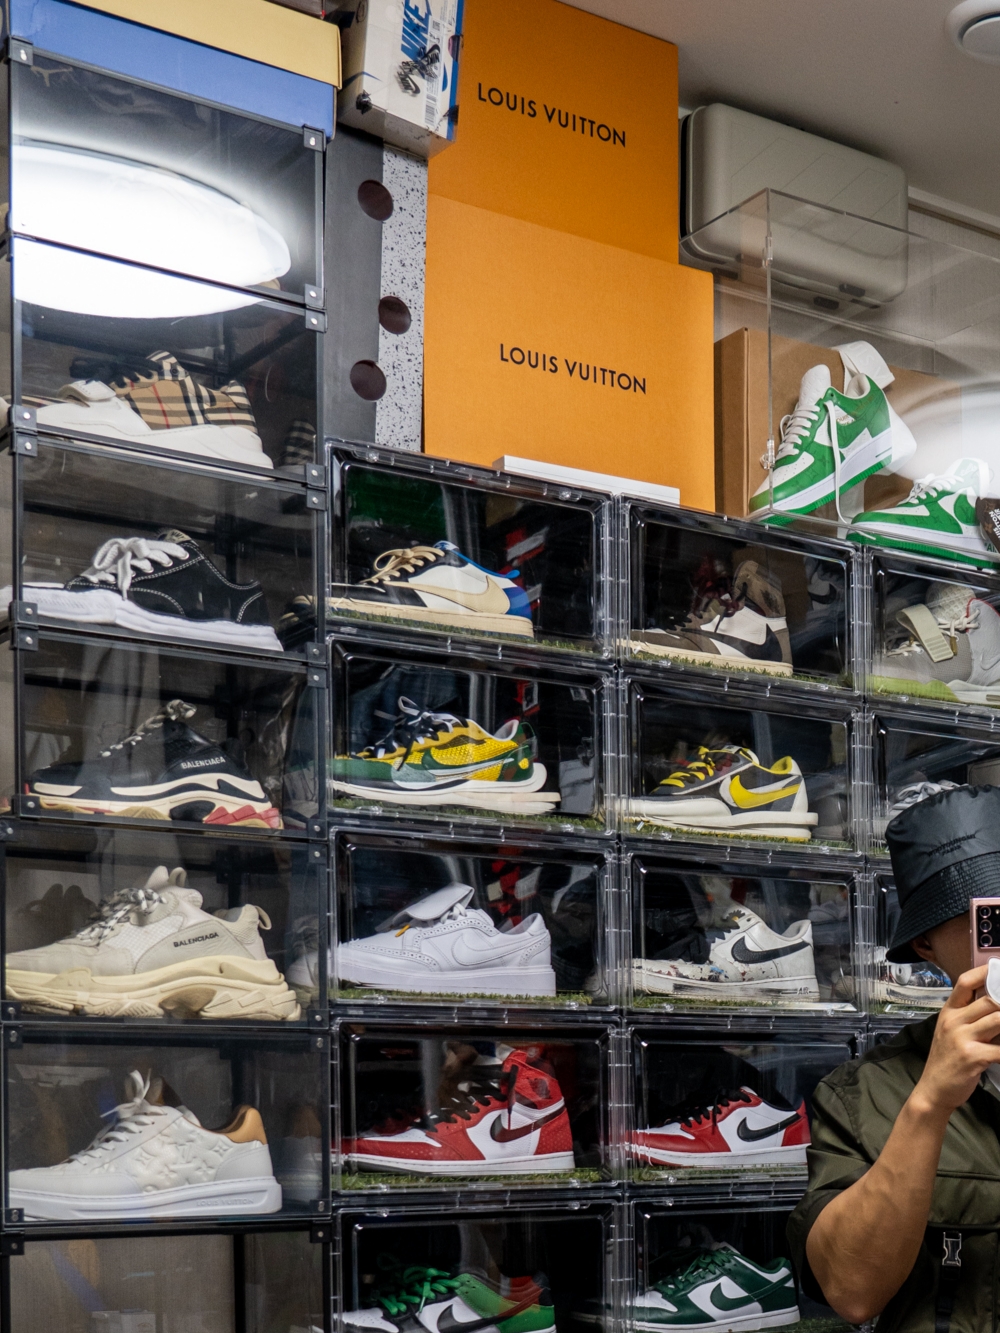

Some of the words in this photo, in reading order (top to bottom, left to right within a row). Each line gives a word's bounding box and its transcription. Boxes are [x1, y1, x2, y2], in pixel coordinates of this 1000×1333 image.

[478, 82, 537, 118] LOUIS
[543, 103, 626, 148] VUITTON
[500, 343, 558, 374] LOUIS
[564, 358, 646, 395] VUITTON
[181, 756, 226, 770] BALENCIAGA
[173, 932, 219, 948] BALENCIAGA
[196, 1199, 219, 1207] LOUIS
[221, 1197, 255, 1206] VUITTON
